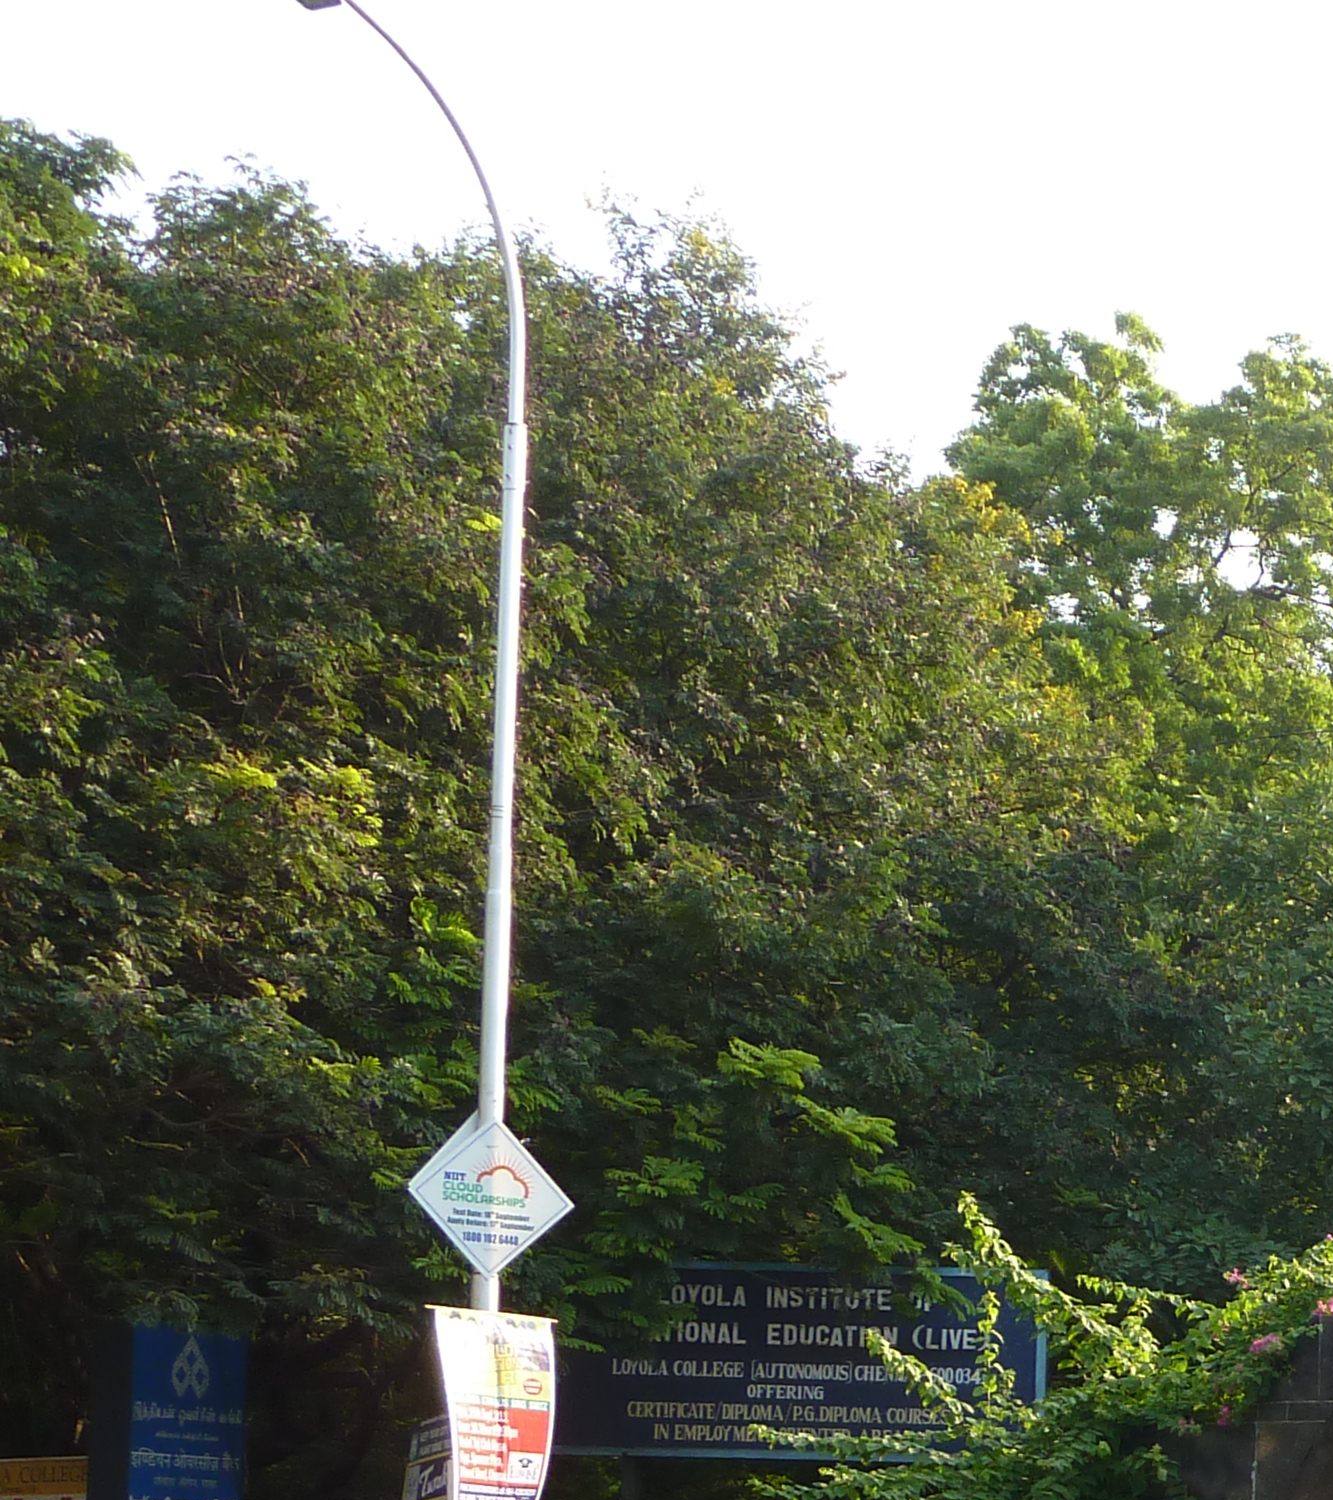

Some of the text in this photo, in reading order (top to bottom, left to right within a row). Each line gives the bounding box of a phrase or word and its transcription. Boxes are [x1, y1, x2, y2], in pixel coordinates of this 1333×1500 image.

[444, 1171, 467, 1181] NIIT
[443, 1181, 483, 1193] CLOUD
[442, 1191, 526, 1208] SCHOLARSHIPS
[496, 1212, 530, 1223] September
[500, 1222, 535, 1232] September
[766, 1285, 892, 1311] INSTITUTE
[767, 1323, 898, 1348] EDUCATION
[612, 1358, 669, 1377] LOYOLA
[673, 1360, 744, 1379] COLLEGE
[746, 1384, 825, 1401] OFFERING
[653, 1423, 671, 1440] IN
[674, 1423, 769, 1442] EMPLOYME
